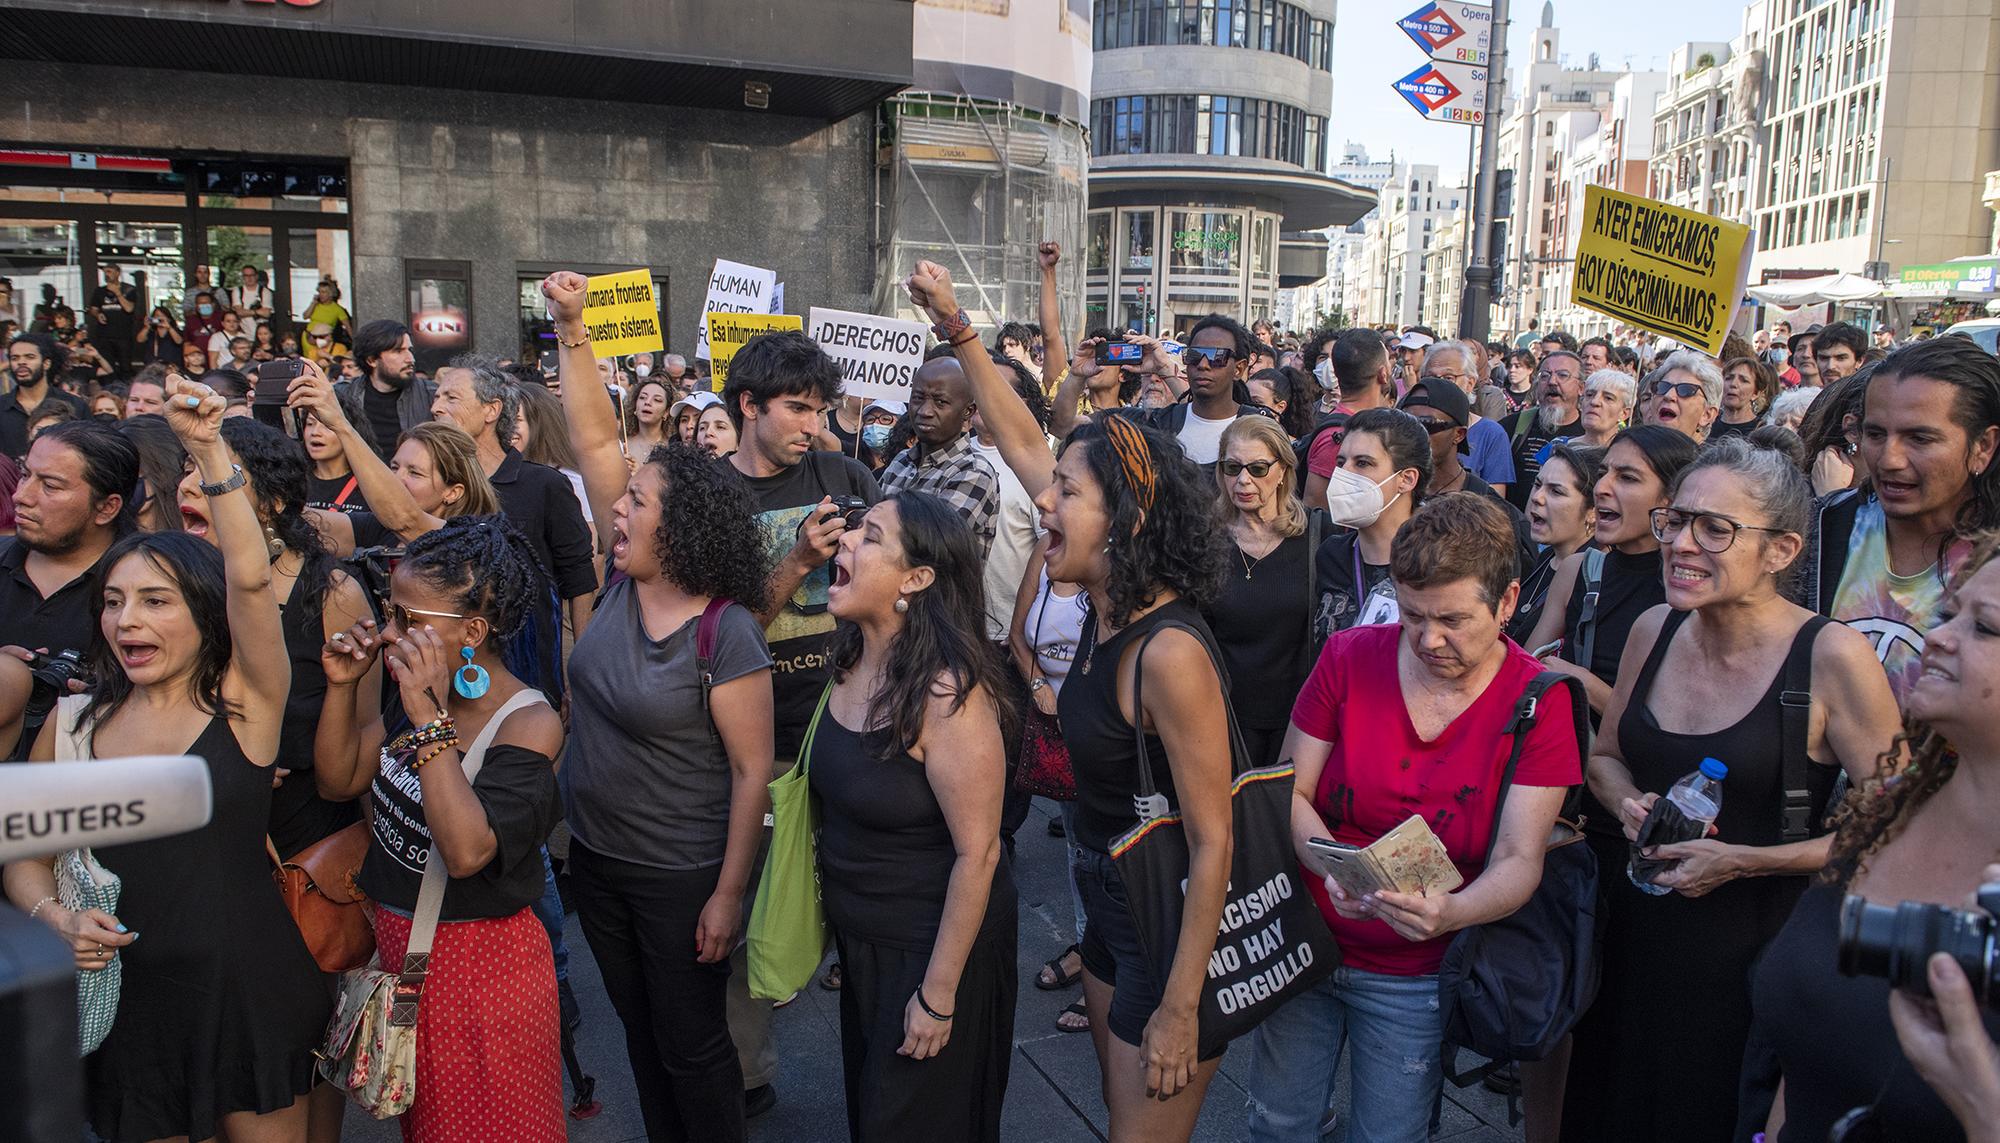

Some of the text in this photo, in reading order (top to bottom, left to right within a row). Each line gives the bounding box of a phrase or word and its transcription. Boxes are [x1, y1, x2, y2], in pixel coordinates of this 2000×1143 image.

[1461, 5, 1490, 21] Ópera
[1403, 20, 1422, 30] Metro
[1429, 24, 1440, 32] 500
[1458, 49, 1486, 61] 2 5 R
[1471, 70, 1487, 81] Sol
[1399, 82, 1418, 92] Metro
[1425, 85, 1437, 94] 400
[1455, 110, 1462, 120] 2
[1466, 111, 1472, 121] 3
[1593, 196, 1632, 243] AYER
[710, 273, 761, 298] HUMAN
[1577, 252, 1607, 296] HOY
[615, 282, 651, 305] frontera
[588, 315, 657, 342] nuestro sistema.
[711, 319, 726, 342] Esa
[815, 322, 921, 356] ¡DERECHOS
[0, 800, 146, 841] EUTERS
[394, 805, 404, 821] sin
[406, 845, 430, 864] so
[1217, 872, 1293, 936] ACISMO
[1206, 917, 1285, 979] NO HAY
[1216, 942, 1314, 1015] ORGULLO
